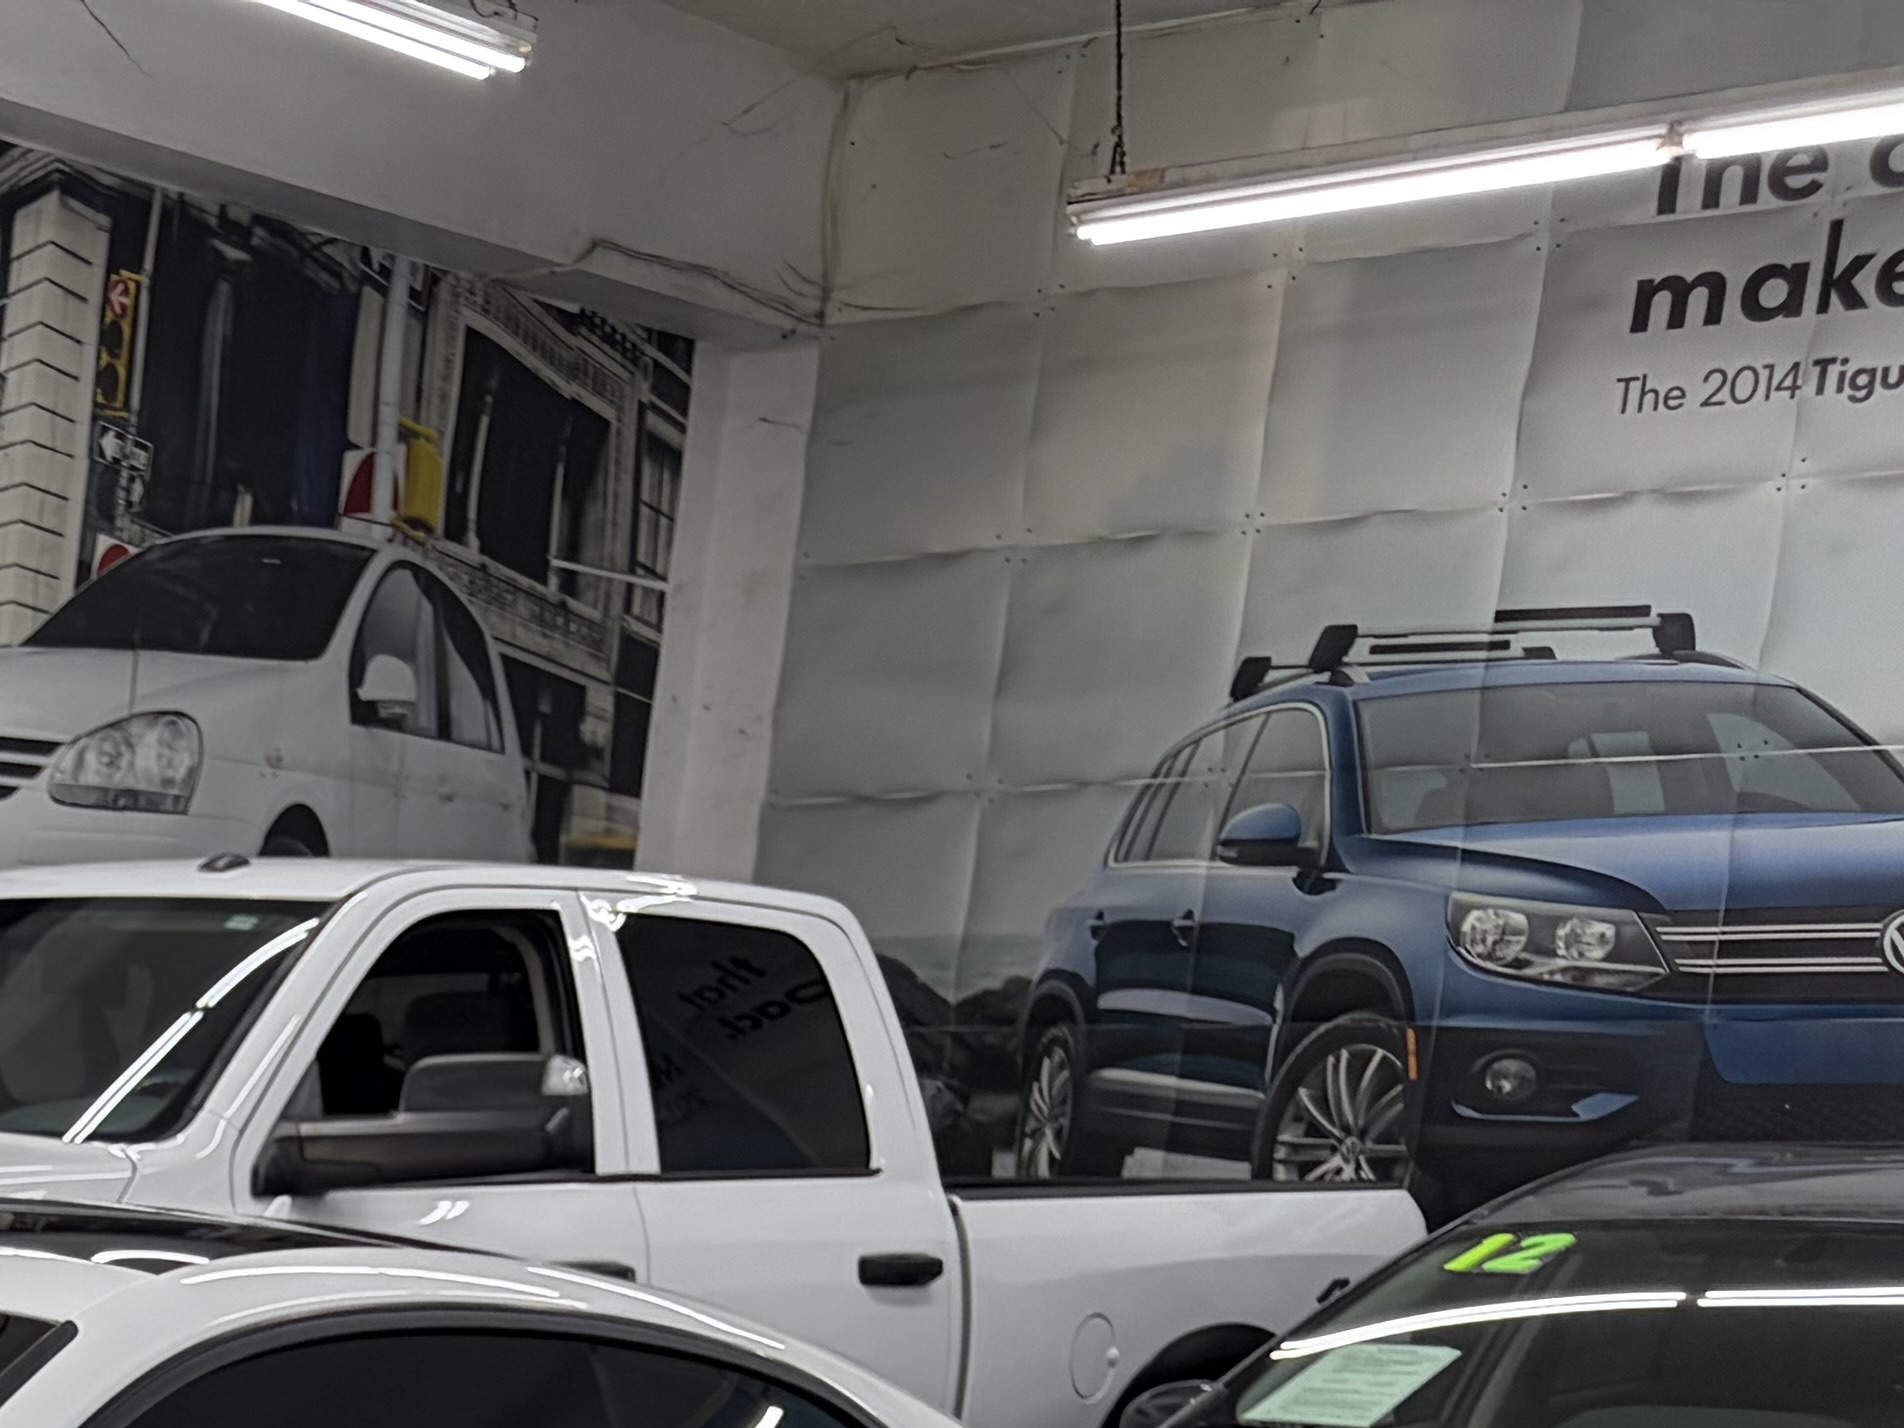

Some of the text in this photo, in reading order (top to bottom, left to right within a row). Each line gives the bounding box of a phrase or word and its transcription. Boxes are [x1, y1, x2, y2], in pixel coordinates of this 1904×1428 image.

[1616, 373, 1688, 415] The
[1699, 361, 1804, 409] 2014
[1443, 1232, 1578, 1275] 12
